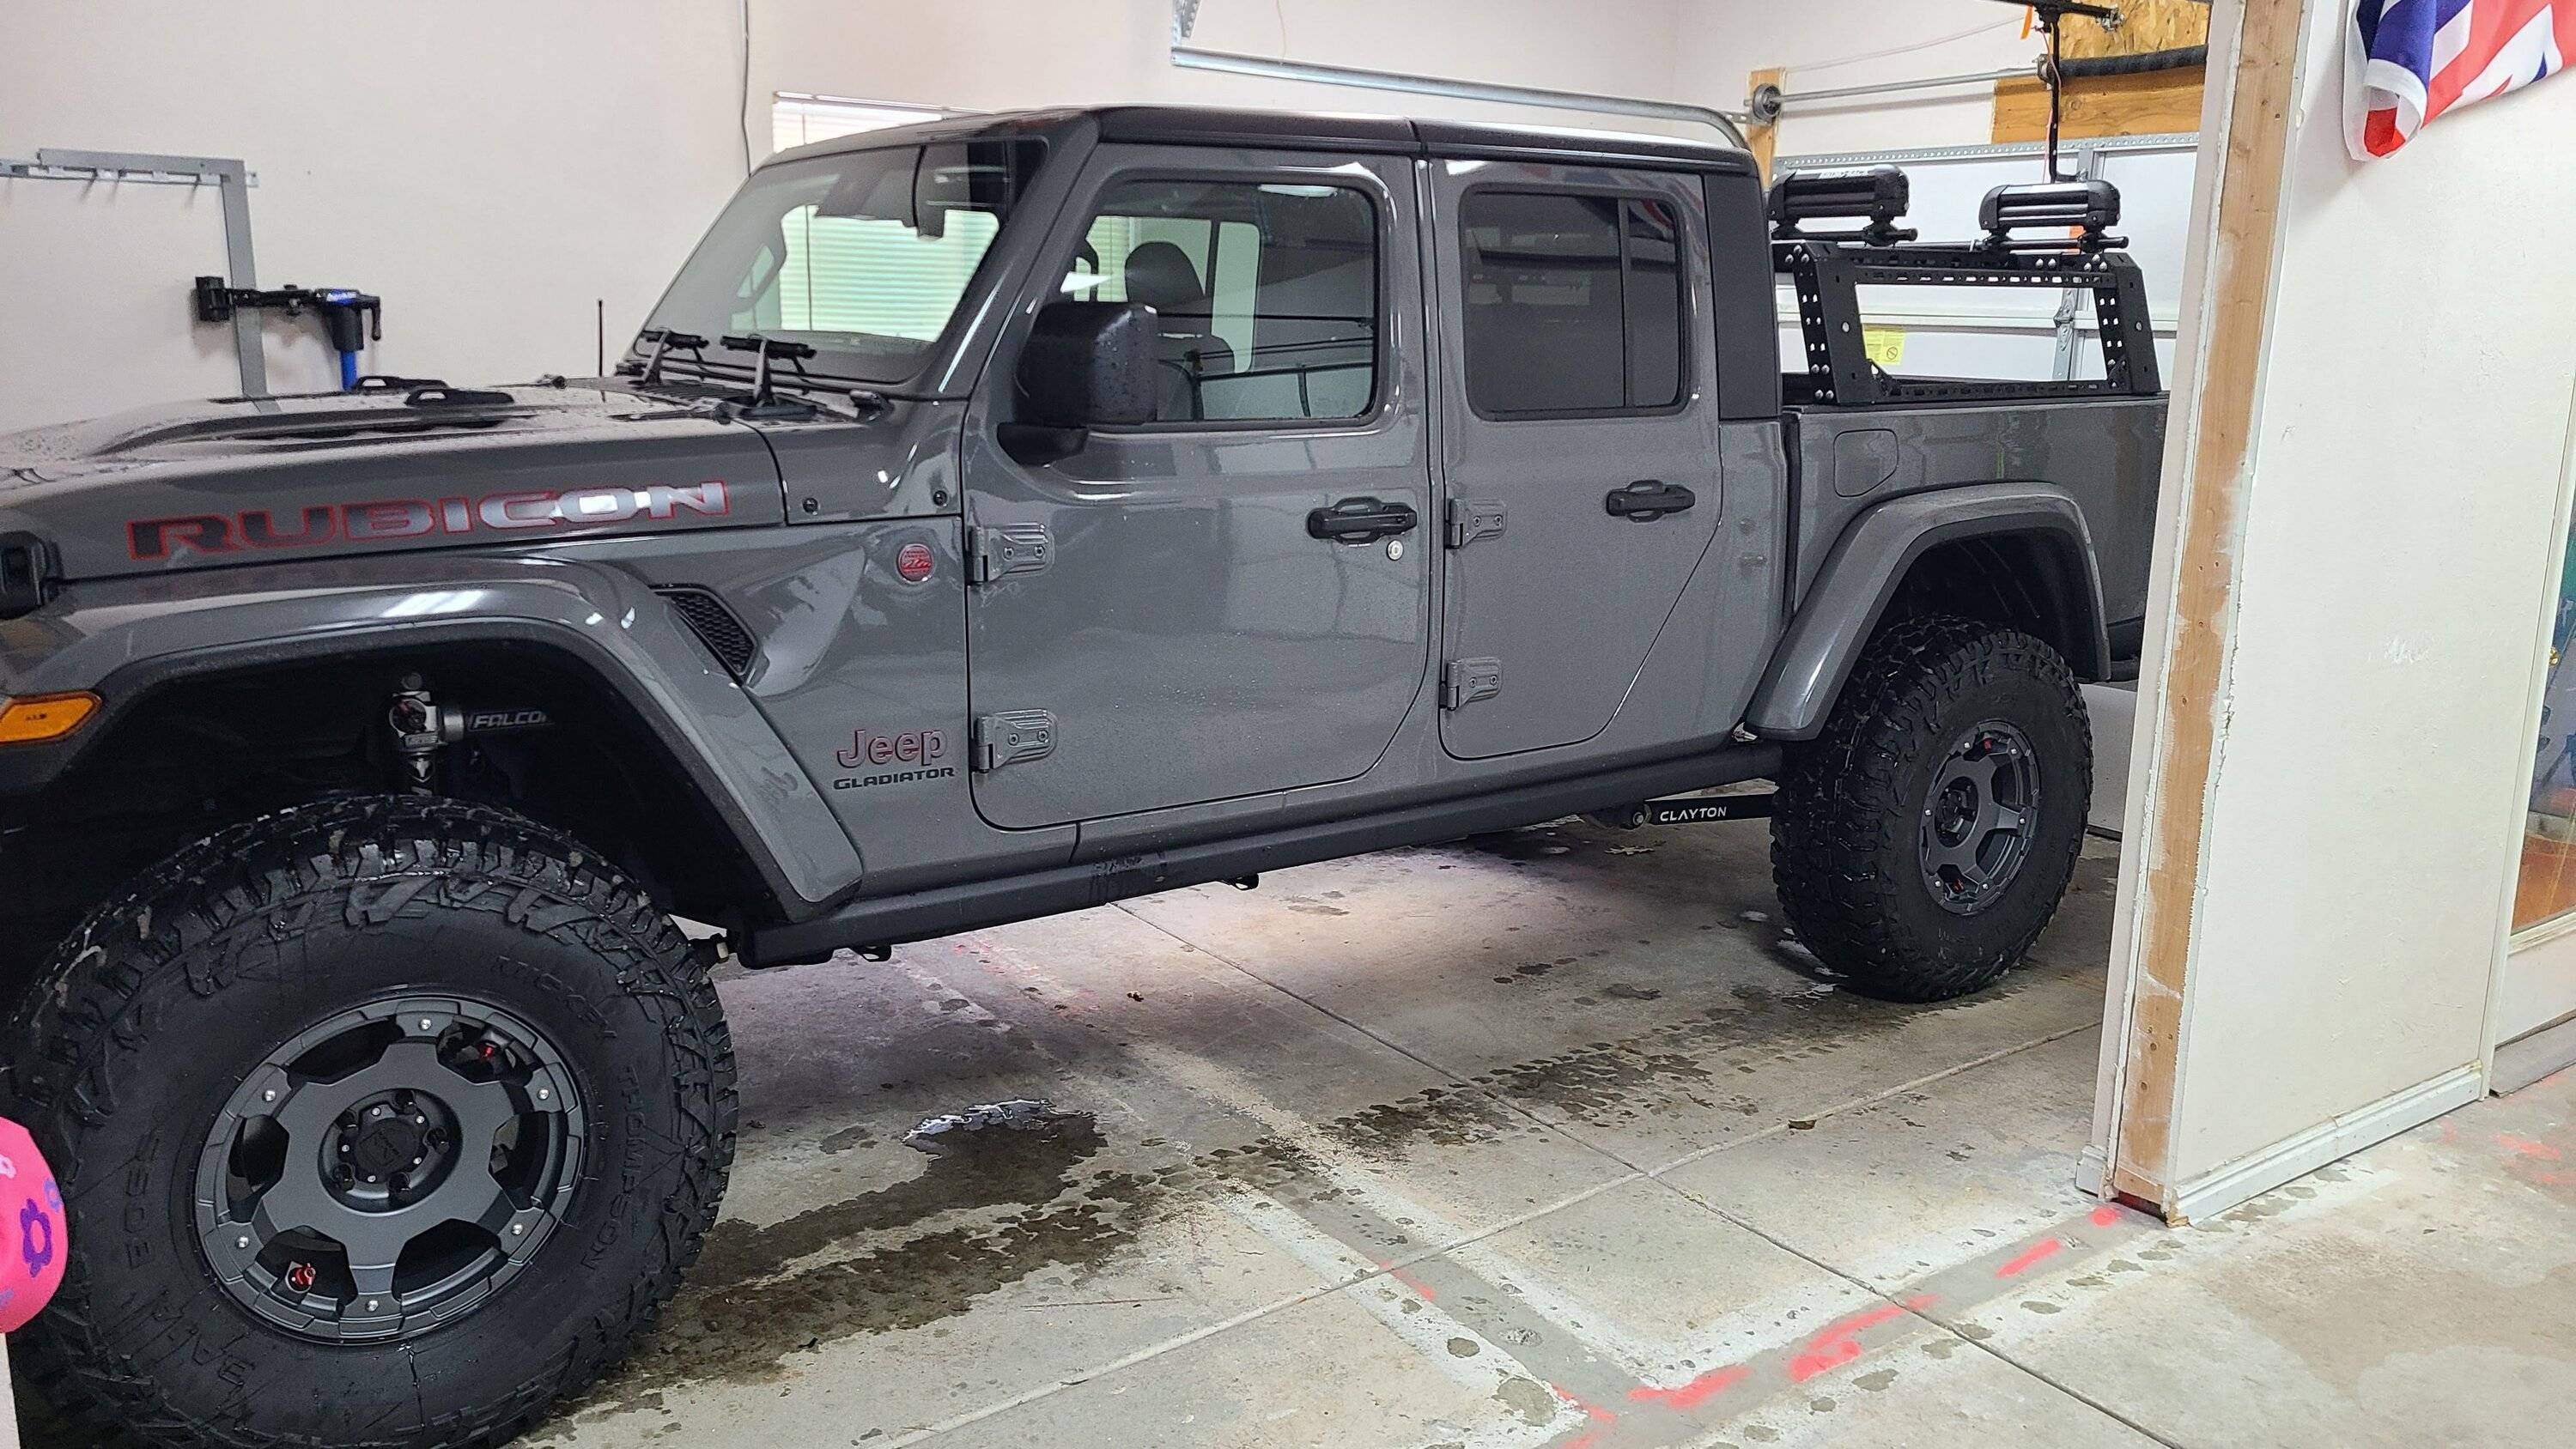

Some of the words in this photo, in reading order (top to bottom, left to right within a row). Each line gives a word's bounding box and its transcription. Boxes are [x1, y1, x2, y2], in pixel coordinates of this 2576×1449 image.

[126, 480, 729, 561] RUBICON
[837, 730, 947, 769] Jeep
[833, 767, 956, 791] GLADIATOR
[1660, 806, 1727, 822] CLAYTON
[580, 1064, 647, 1271] THOMPSON
